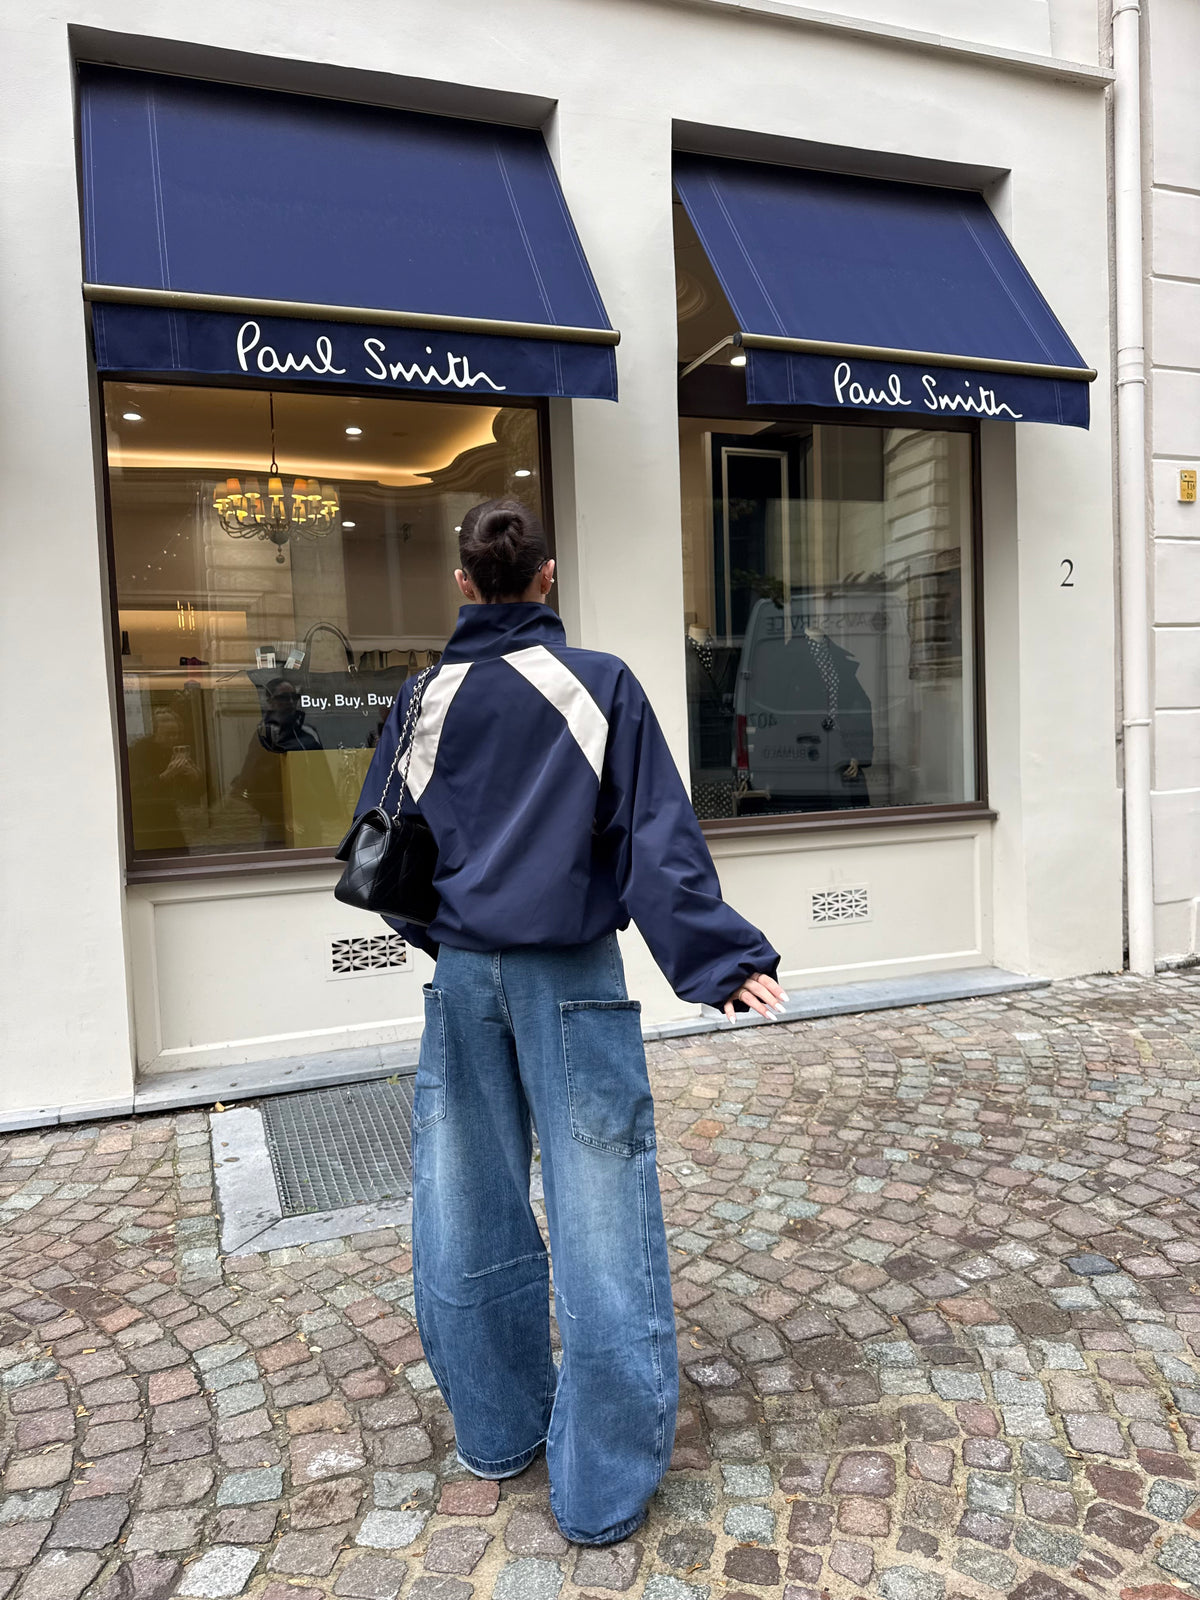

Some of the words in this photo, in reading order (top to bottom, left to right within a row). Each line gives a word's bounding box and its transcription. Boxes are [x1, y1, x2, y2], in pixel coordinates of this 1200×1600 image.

[236, 320, 347, 375] Paul
[363, 337, 507, 391] Smith
[833, 361, 912, 406] Paul
[921, 374, 1023, 419] Smith
[1060, 558, 1074, 587] 2
[300, 695, 331, 710] Buy.
[334, 694, 364, 709] Buy.
[367, 693, 396, 708] Buy.
